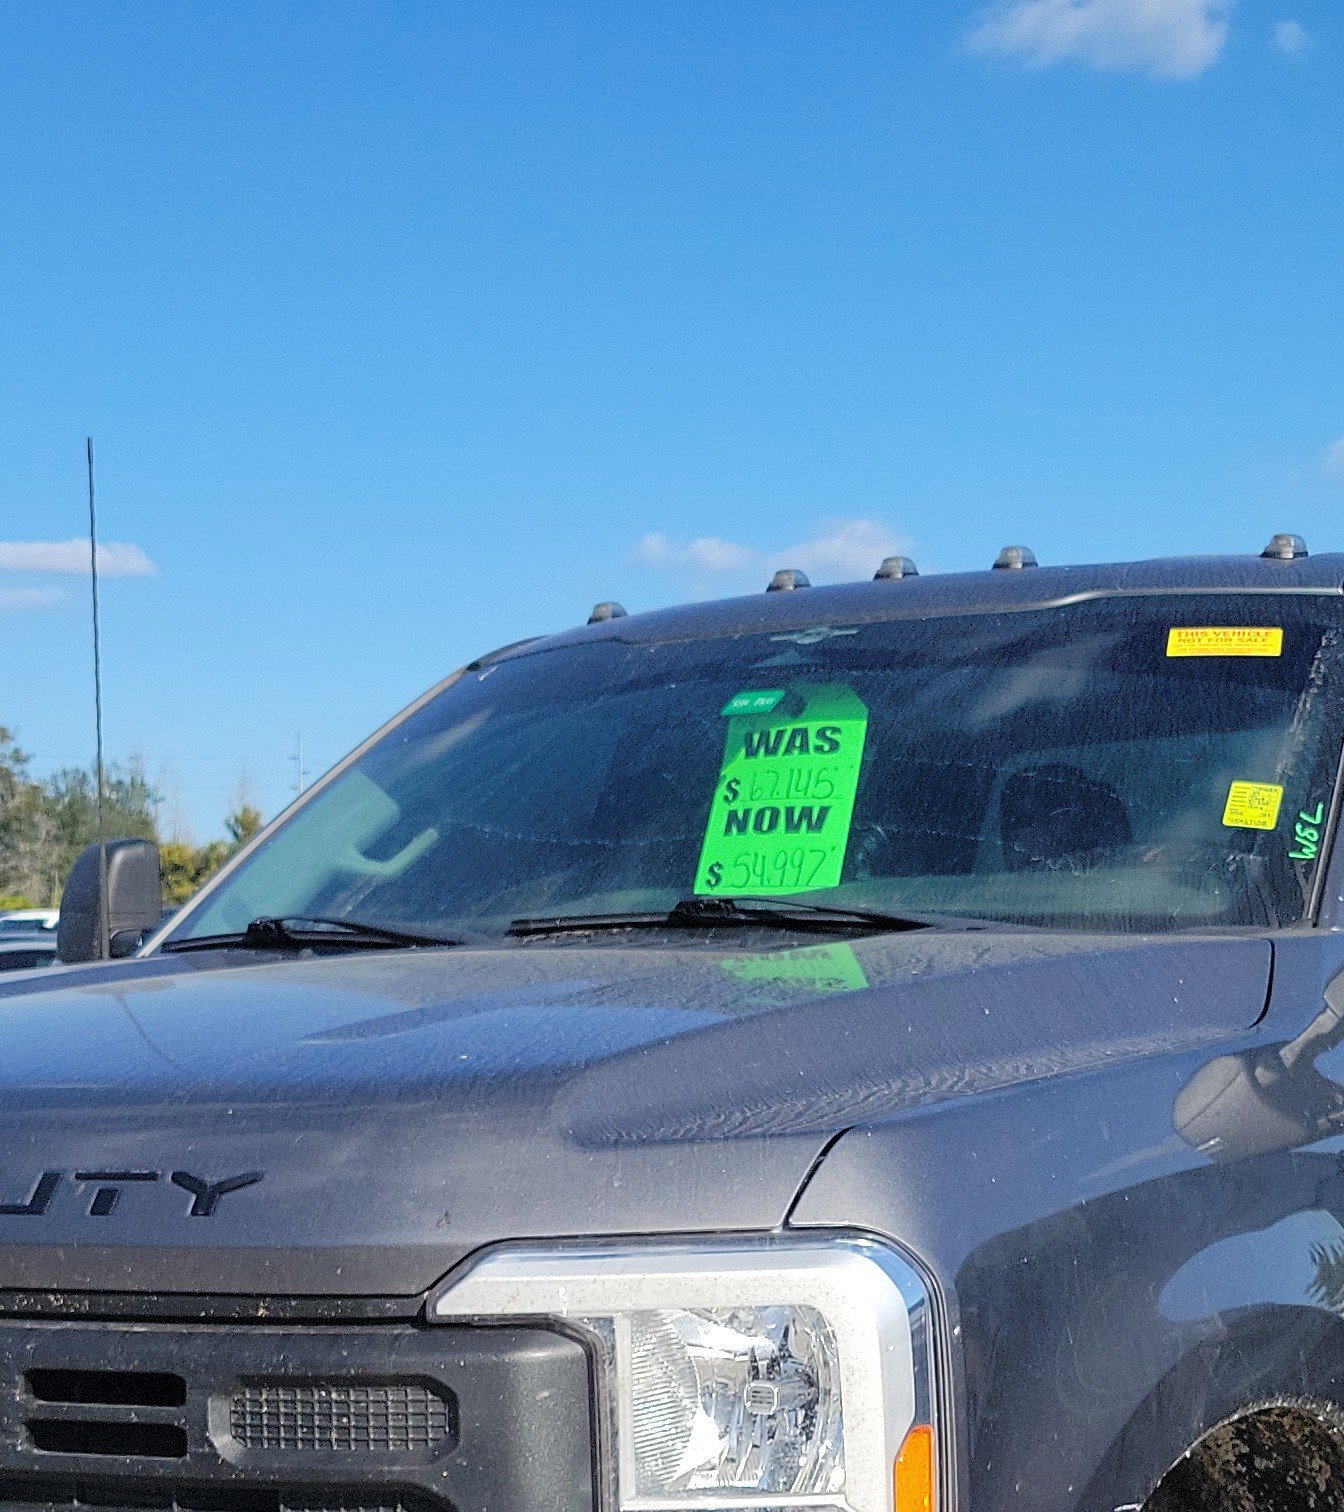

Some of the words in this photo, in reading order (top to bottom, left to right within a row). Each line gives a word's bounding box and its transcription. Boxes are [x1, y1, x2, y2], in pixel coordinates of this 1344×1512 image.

[1177, 630, 1210, 638] THIS
[1213, 630, 1273, 638] VEHICLE
[744, 726, 841, 759] WAS
[723, 777, 741, 805] $
[724, 806, 831, 836] NOW
[706, 860, 724, 890] $
